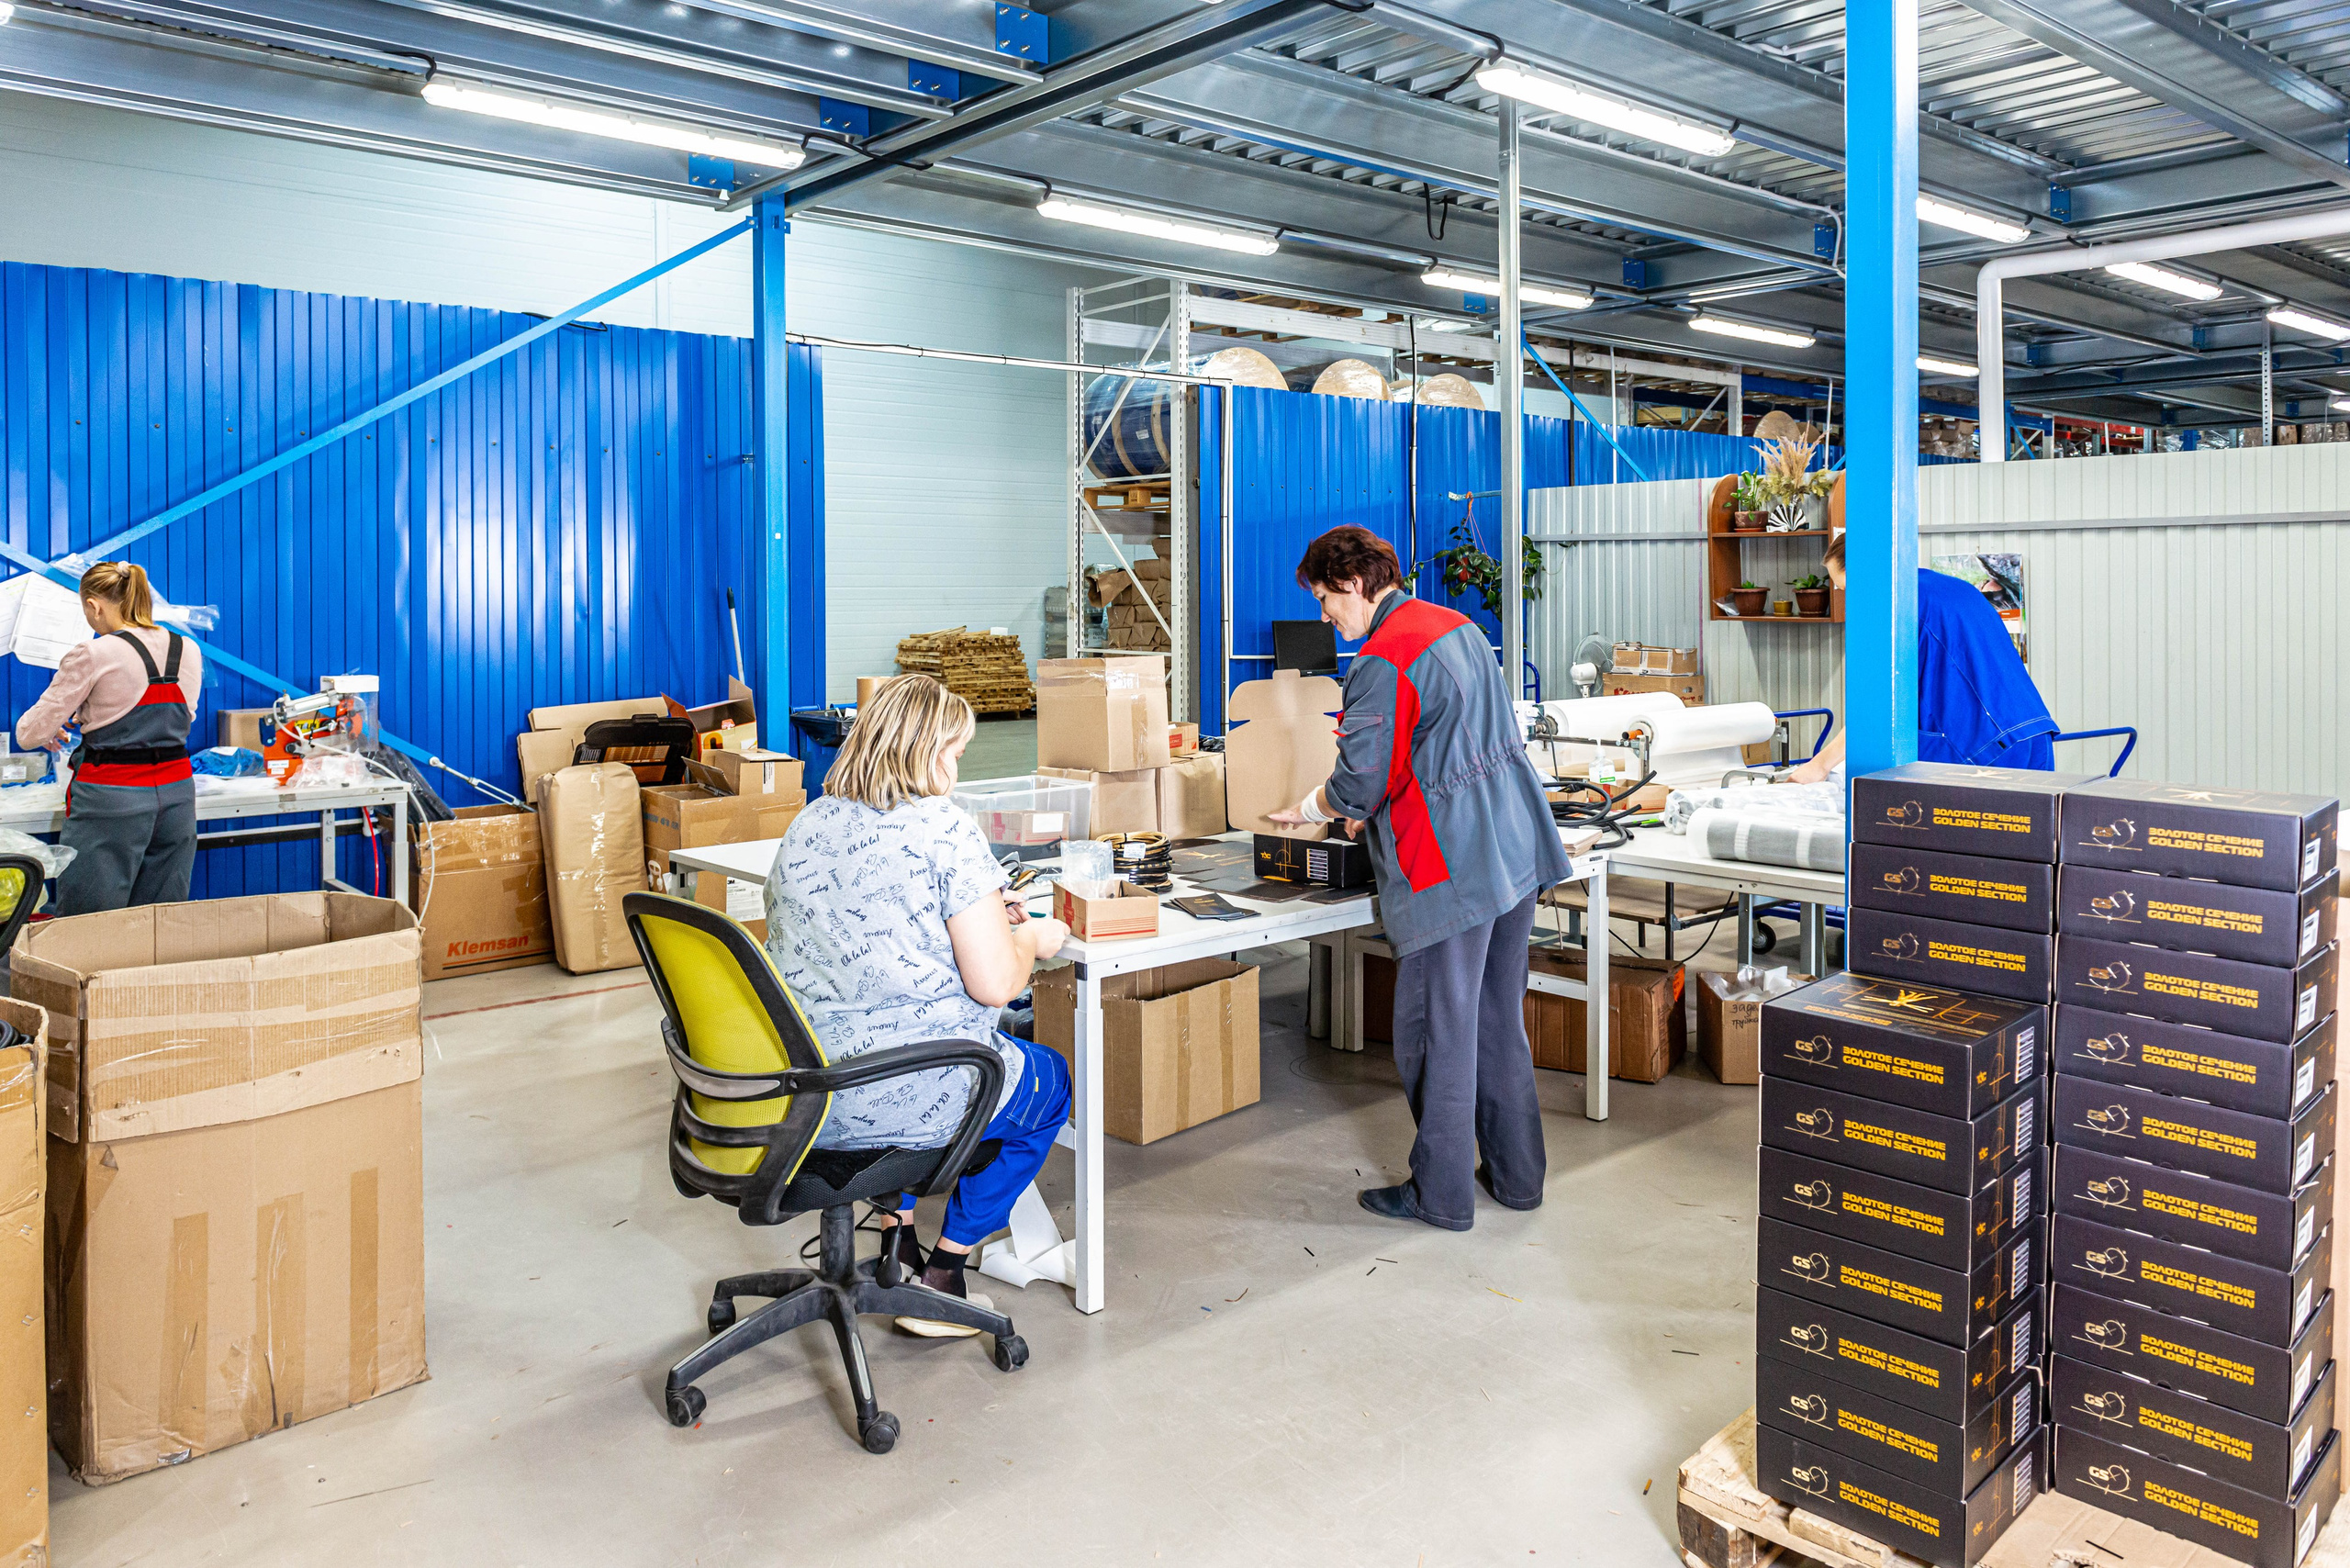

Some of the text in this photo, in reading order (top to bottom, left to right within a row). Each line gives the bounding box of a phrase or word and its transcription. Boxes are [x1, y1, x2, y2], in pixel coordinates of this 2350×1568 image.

[1887, 807, 1905, 817] GS
[1932, 807, 2031, 823] ЗОЛОТОЕ СЕЧЕНИЕ
[1932, 815, 2031, 833] GOLDEN SECTION
[2147, 835, 2263, 857] GOLDEN SECTION
[2148, 827, 2263, 847] ЗОЛОТОЕ СЕЧЕНИЕ
[1885, 873, 1901, 883] GS
[1929, 874, 2026, 893] ЗОЛОТОЕ СЕЧЕНИЕ
[1929, 882, 2026, 902] GOLDEN SECTION
[2146, 909, 2262, 934] GOLDEN SECTION
[2147, 900, 2262, 924] ЗОЛОТОЕ СЕЧЕНИЕ
[447, 935, 529, 957] Klemsan
[1883, 938, 1900, 949] GS
[1928, 941, 2025, 963] ЗОЛОТОЕ СЕЧЕНИЕ
[1928, 949, 2025, 971] GOLDEN SECTION
[2143, 971, 2258, 999] ЗОЛОТОЕ СЕЧЕНИЕ
[2143, 980, 2258, 1008] GOLDEN SECTION
[1796, 1040, 1813, 1052] GS
[2087, 1038, 2107, 1051] GS
[1841, 1055, 1943, 1084] GOLDEN SECTION
[1842, 1046, 1943, 1074] ЗОЛОТОЕ СЕЧЕНИЕ
[2141, 1053, 2255, 1084] GOLDEN SECTION
[2142, 1044, 2256, 1074] ЗОЛОТОЕ СЕЧЕНИЕ
[1796, 1112, 1814, 1125] GS
[2087, 1109, 2107, 1122] GS
[1843, 1119, 1946, 1150] ЗОЛОТОЕ СЕЧЕНИЕ
[1843, 1128, 1945, 1160] GOLDEN SECTION
[2141, 1125, 2256, 1159] GOLDEN SECTION
[2142, 1115, 2256, 1149] ЗОЛОТОЕ СЕЧЕНИЕ
[1795, 1183, 1812, 1196] GS
[2087, 1181, 2108, 1193] GS
[1841, 1191, 1944, 1226] ЗОЛОТОЕ СЕЧЕНИЕ
[1841, 1200, 1943, 1236] GOLDEN SECTION
[2142, 1198, 2257, 1235] GOLDEN SECTION
[2143, 1189, 2257, 1225] ЗОЛОТОЕ СЕЧЕНИЕ
[1793, 1255, 1810, 1269] GS
[2086, 1250, 2106, 1264] GS
[1840, 1265, 1942, 1302] ЗОЛОТОЕ СЕЧЕНИЕ
[1840, 1274, 1942, 1312] GOLDEN SECTION
[2140, 1260, 2255, 1299] ЗОЛОТОЕ СЕЧЕНИЕ
[2140, 1269, 2255, 1308] GOLDEN SECTION
[1791, 1327, 1809, 1340] GS
[2085, 1322, 2105, 1336] GS
[1838, 1337, 1939, 1378] ЗОЛОТОЕ СЕЧЕНИЕ
[1838, 1347, 1939, 1388] GOLDEN SECTION
[2140, 1333, 2255, 1375] ЗОЛОТОЕ СЕЧЕНИЕ
[2140, 1342, 2255, 1385] GOLDEN SECTION
[1791, 1395, 1808, 1410] GS
[2084, 1393, 2104, 1407] GS
[1837, 1408, 1938, 1452] ЗОЛОТОЕ СЕЧЕНИЕ
[1837, 1417, 1938, 1462] GOLDEN SECTION
[2138, 1406, 2253, 1451] ЗОЛОТОЕ СЕЧЕНИЕ
[2138, 1415, 2252, 1462] GOLDEN SECTION
[1792, 1466, 1810, 1482] GS
[2088, 1466, 2109, 1481] GS
[1839, 1480, 1939, 1528] ЗОЛОТОЕ СЕЧЕНИЕ
[1839, 1489, 1886, 1516] GOLDEN
[1887, 1508, 1940, 1537] SECTION
[2143, 1480, 2258, 1529] ЗОЛОТОЕ СЕЧЕНИЕ
[2143, 1489, 2258, 1539] GOLDEN SECTION
